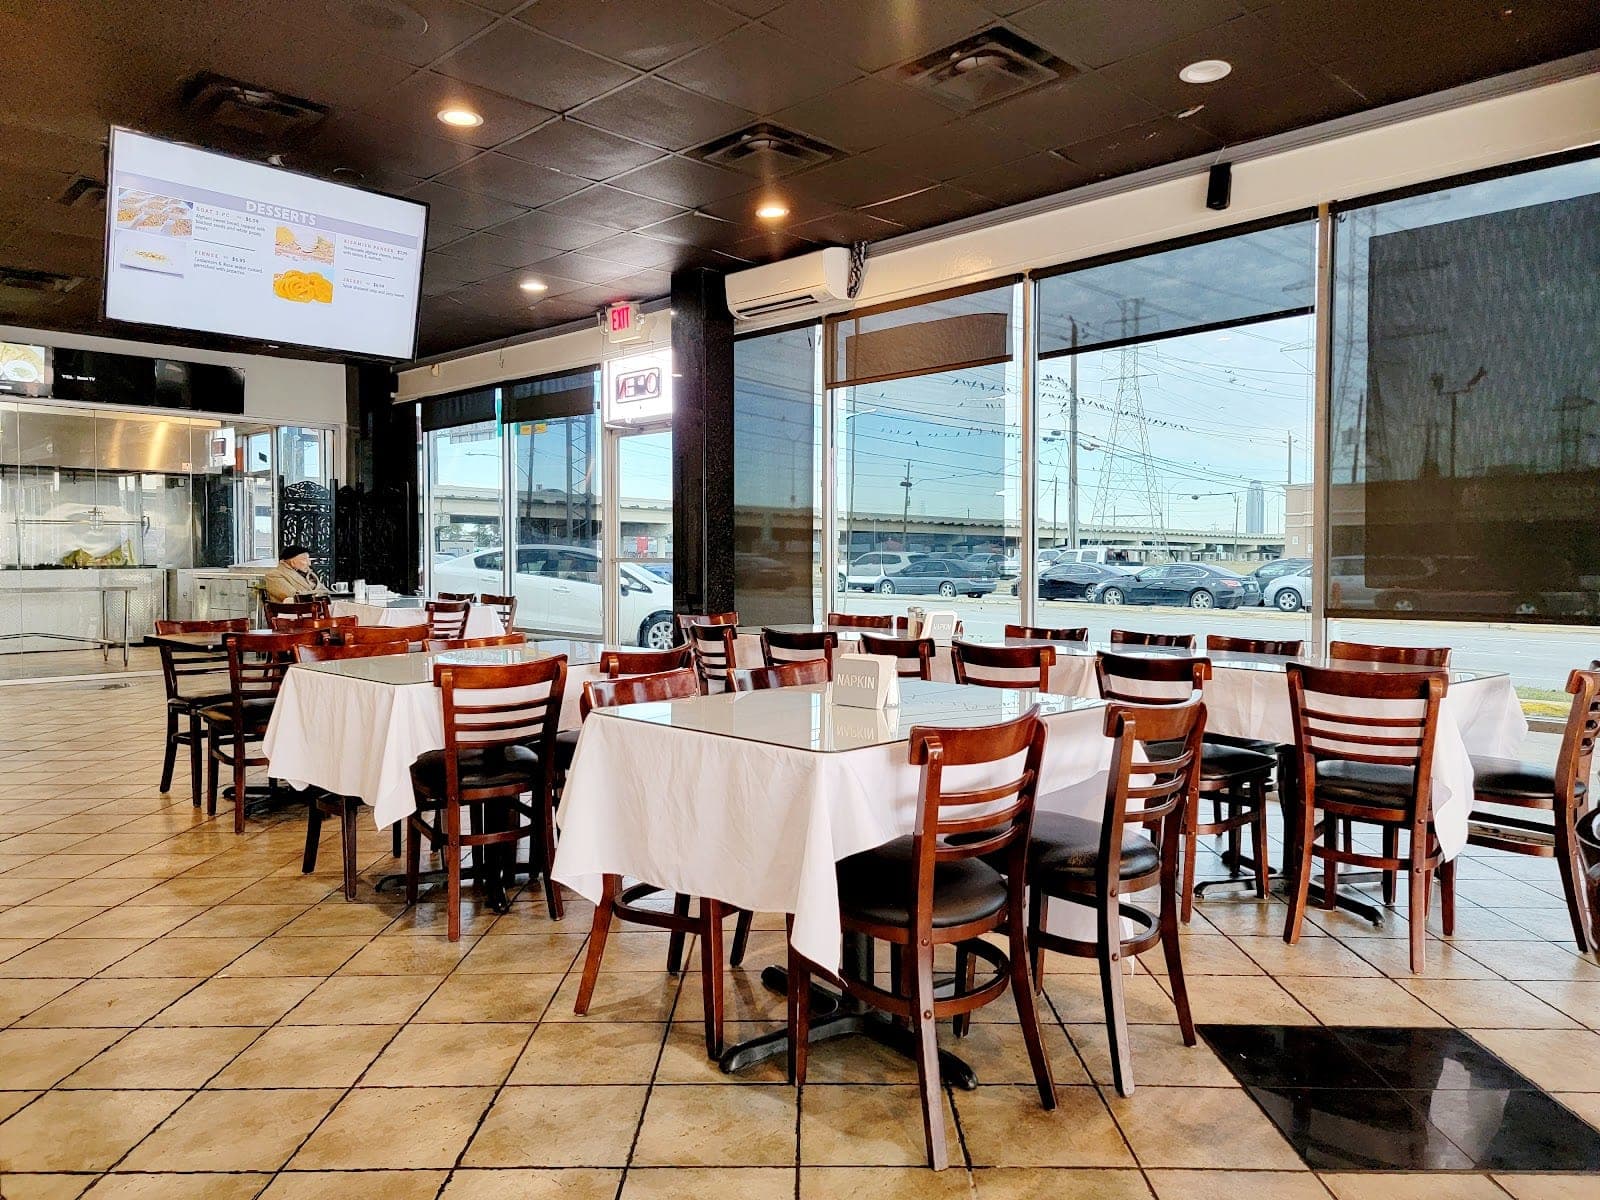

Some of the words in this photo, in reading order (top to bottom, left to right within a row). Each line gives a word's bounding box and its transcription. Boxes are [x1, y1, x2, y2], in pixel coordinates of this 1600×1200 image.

[245, 200, 317, 226] DESSERTS
[611, 306, 631, 331] EXIT
[837, 673, 875, 689] NAPKIN
